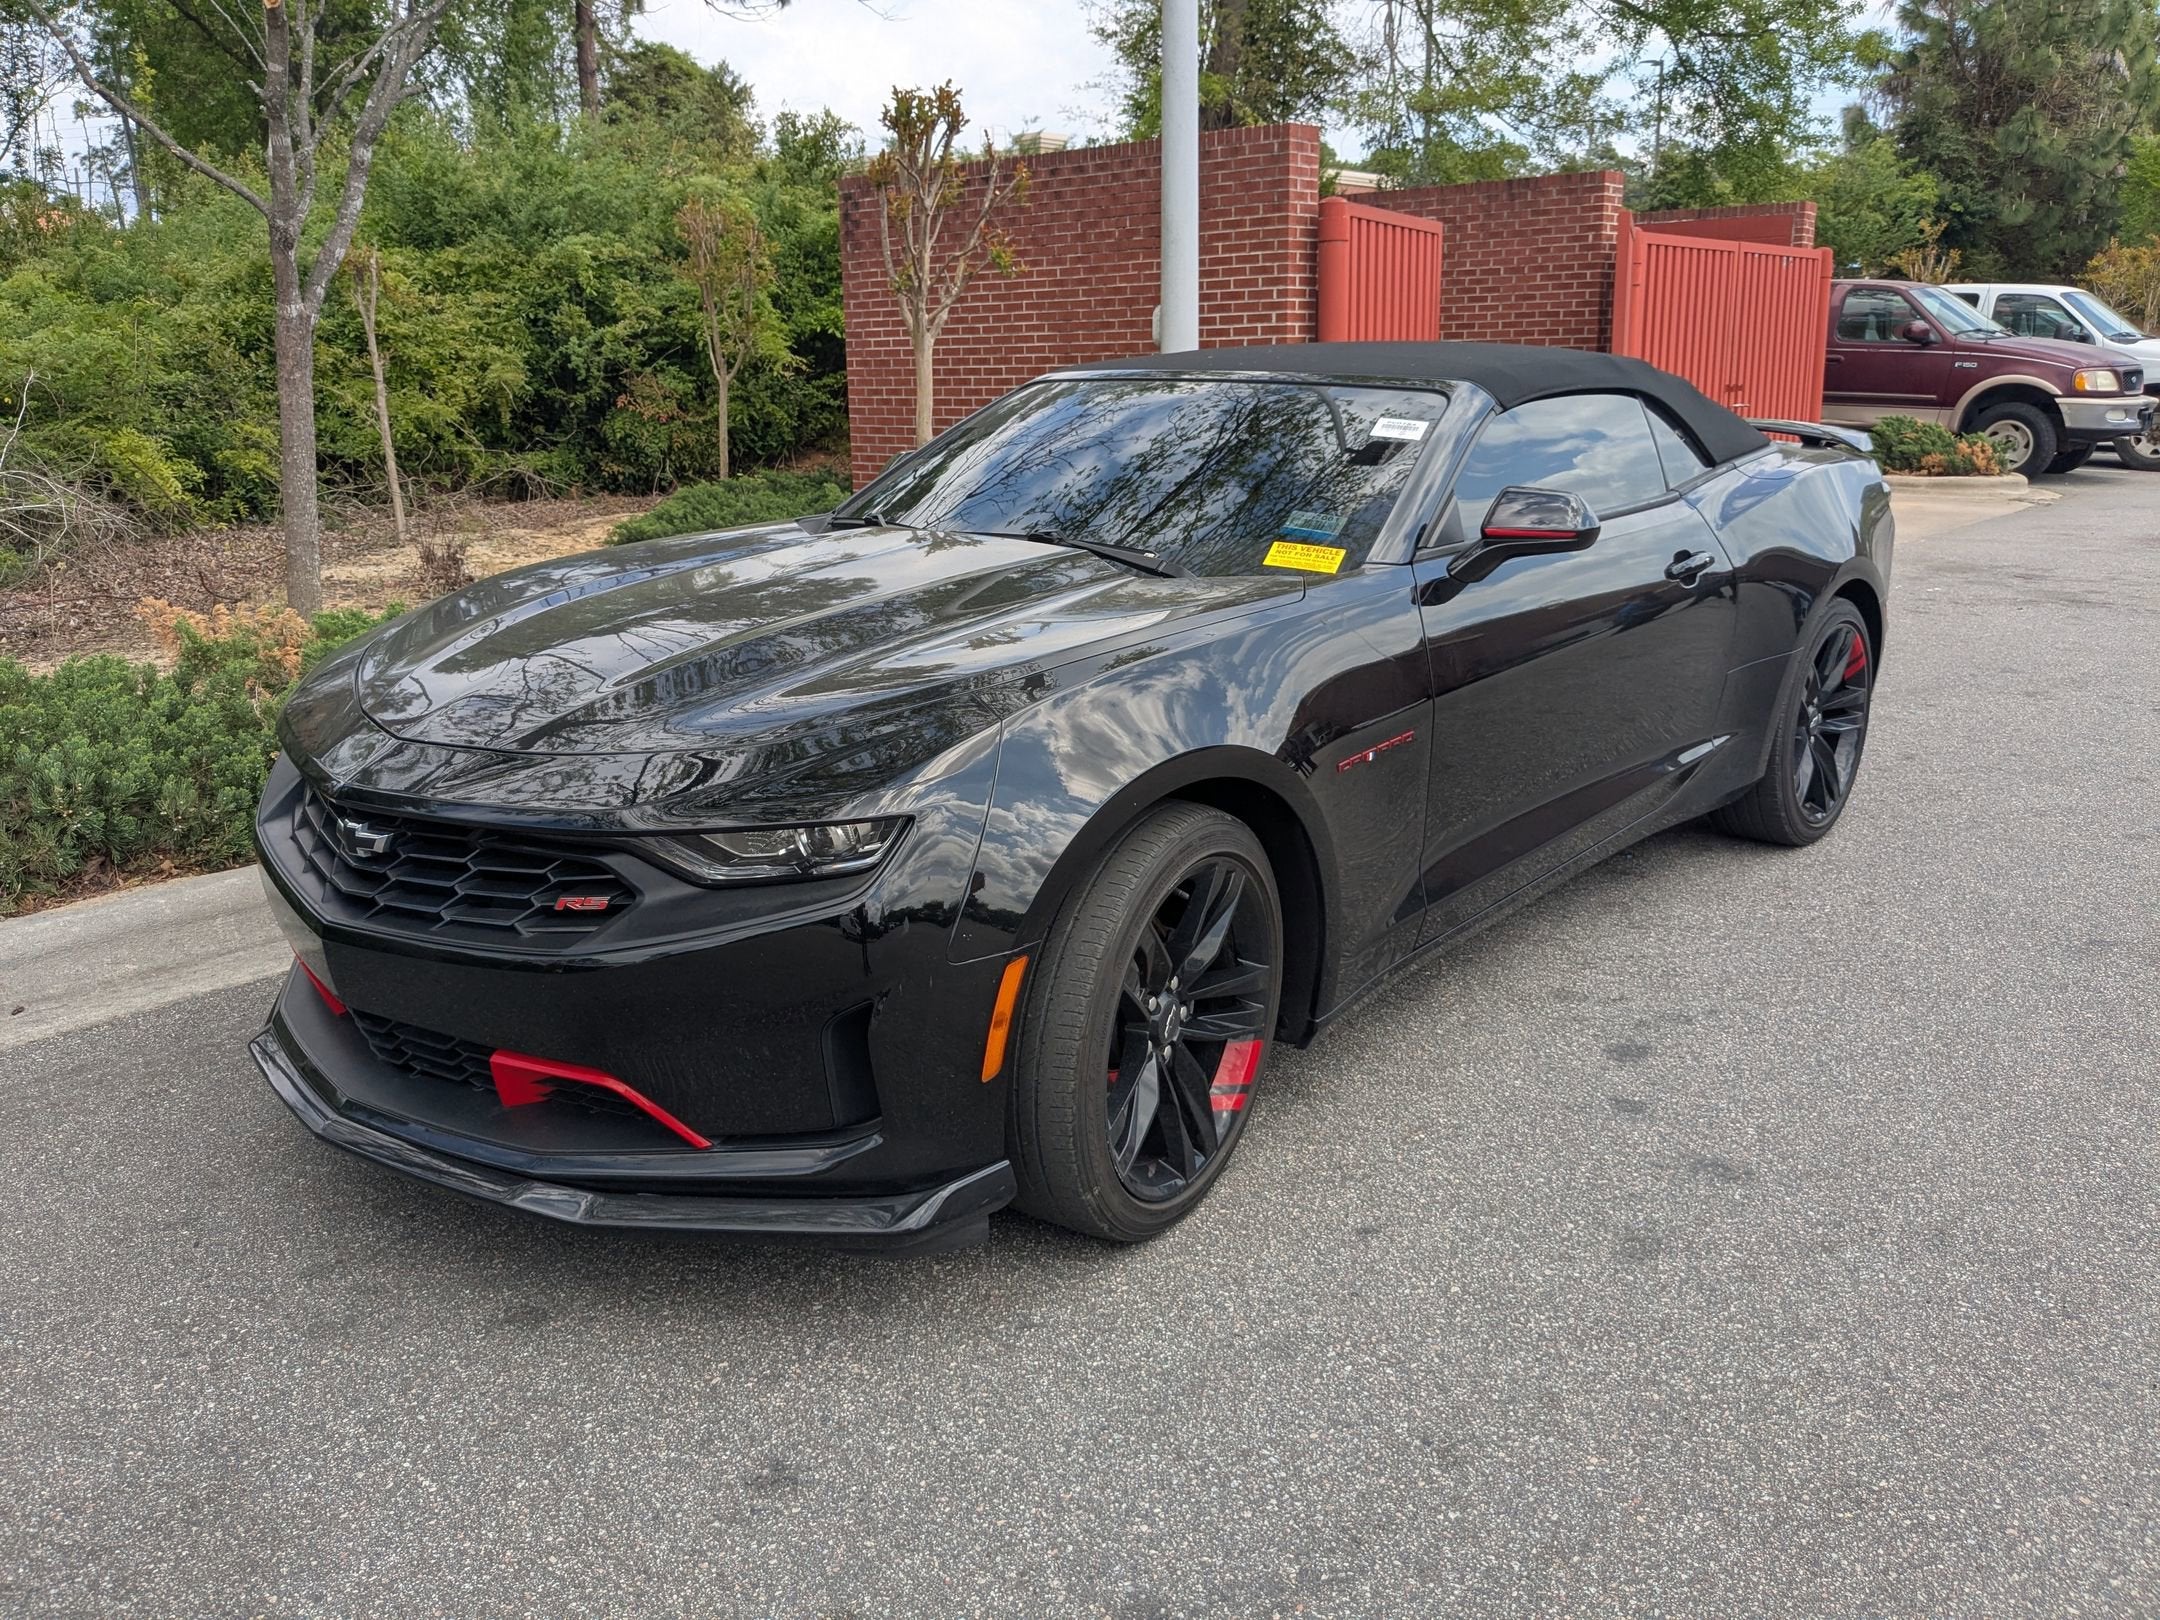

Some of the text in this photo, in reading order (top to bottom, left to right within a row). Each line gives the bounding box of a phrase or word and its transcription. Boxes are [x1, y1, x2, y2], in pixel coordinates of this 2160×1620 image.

[1276, 543, 1341, 556] THIS VEHICLE
[1314, 553, 1337, 561] SALE
[553, 896, 611, 911] RS
